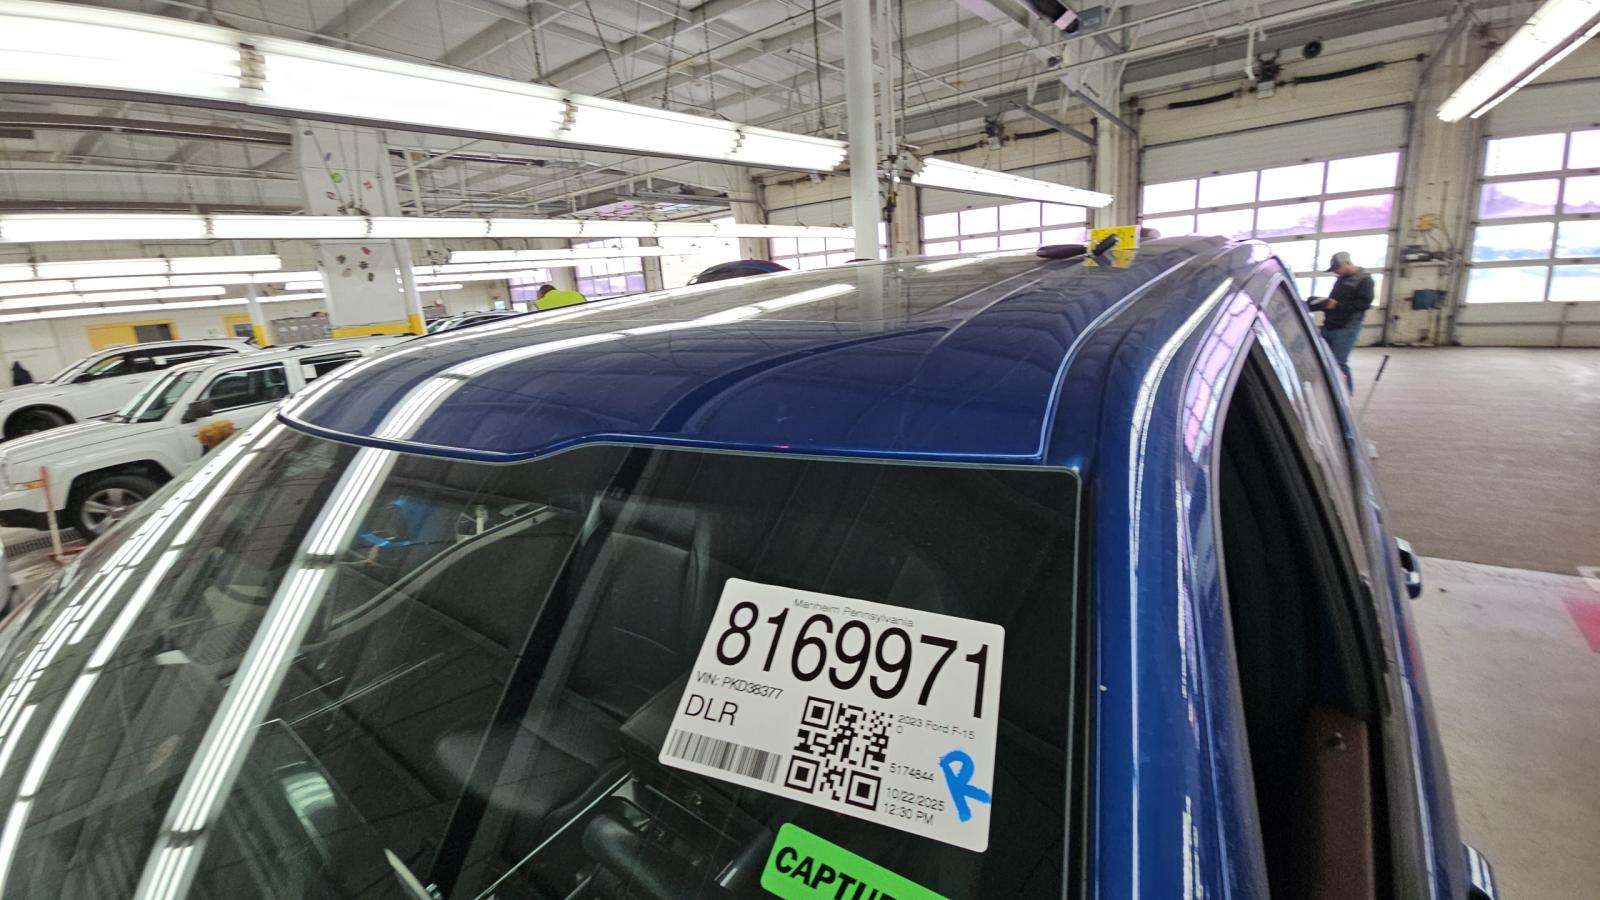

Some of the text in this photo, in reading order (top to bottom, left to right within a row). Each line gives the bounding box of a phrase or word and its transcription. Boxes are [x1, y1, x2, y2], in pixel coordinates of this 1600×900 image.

[794, 599, 840, 613] Manheim
[716, 601, 989, 719] 8169971
[697, 671, 784, 700] VIN: PKD38377
[684, 693, 738, 726] DLR
[898, 714, 922, 728] 2023
[926, 719, 949, 734] Ford
[887, 787, 945, 812] 10/22/2025
[938, 749, 992, 823] R
[884, 803, 934, 825] 12:30 PM
[775, 846, 897, 900] CAPTU
